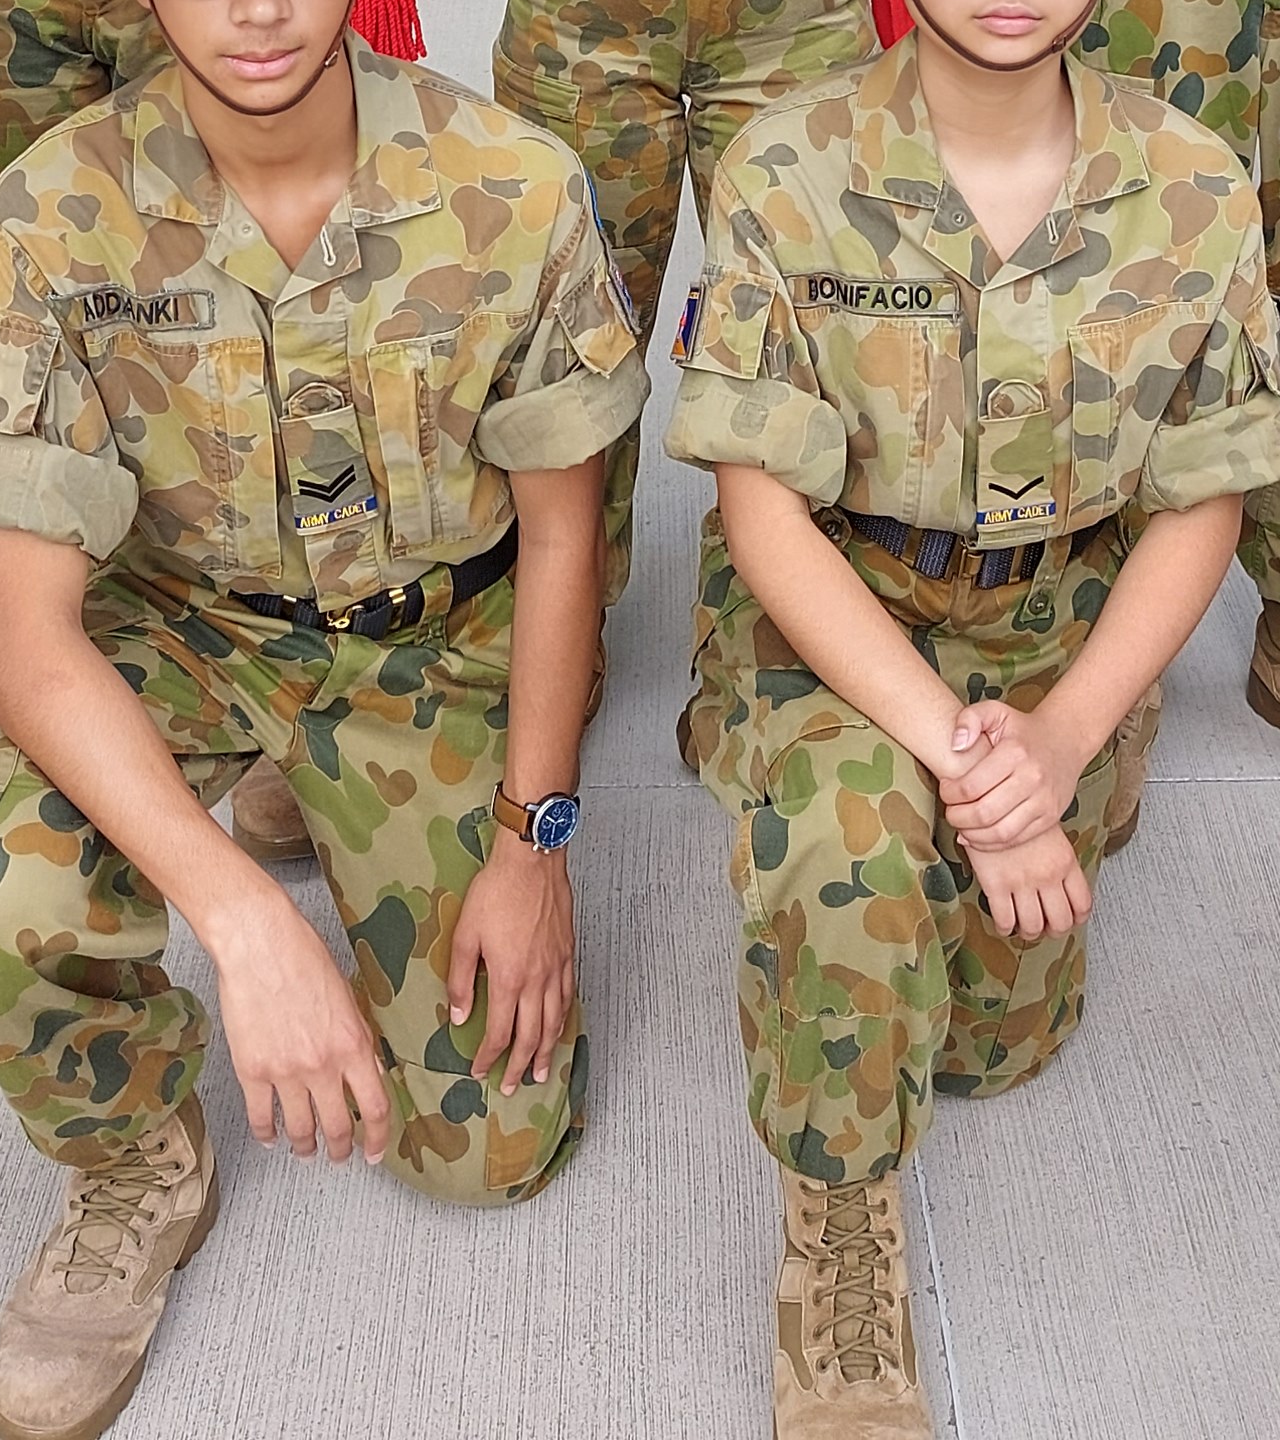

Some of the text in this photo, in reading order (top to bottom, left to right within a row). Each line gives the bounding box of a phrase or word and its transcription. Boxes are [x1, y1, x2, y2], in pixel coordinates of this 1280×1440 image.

[83, 292, 179, 325] ADDANKI
[808, 277, 932, 310] BONIFACIO
[300, 500, 367, 528] ARMY CADET
[984, 504, 1051, 524] ARMY CADET
